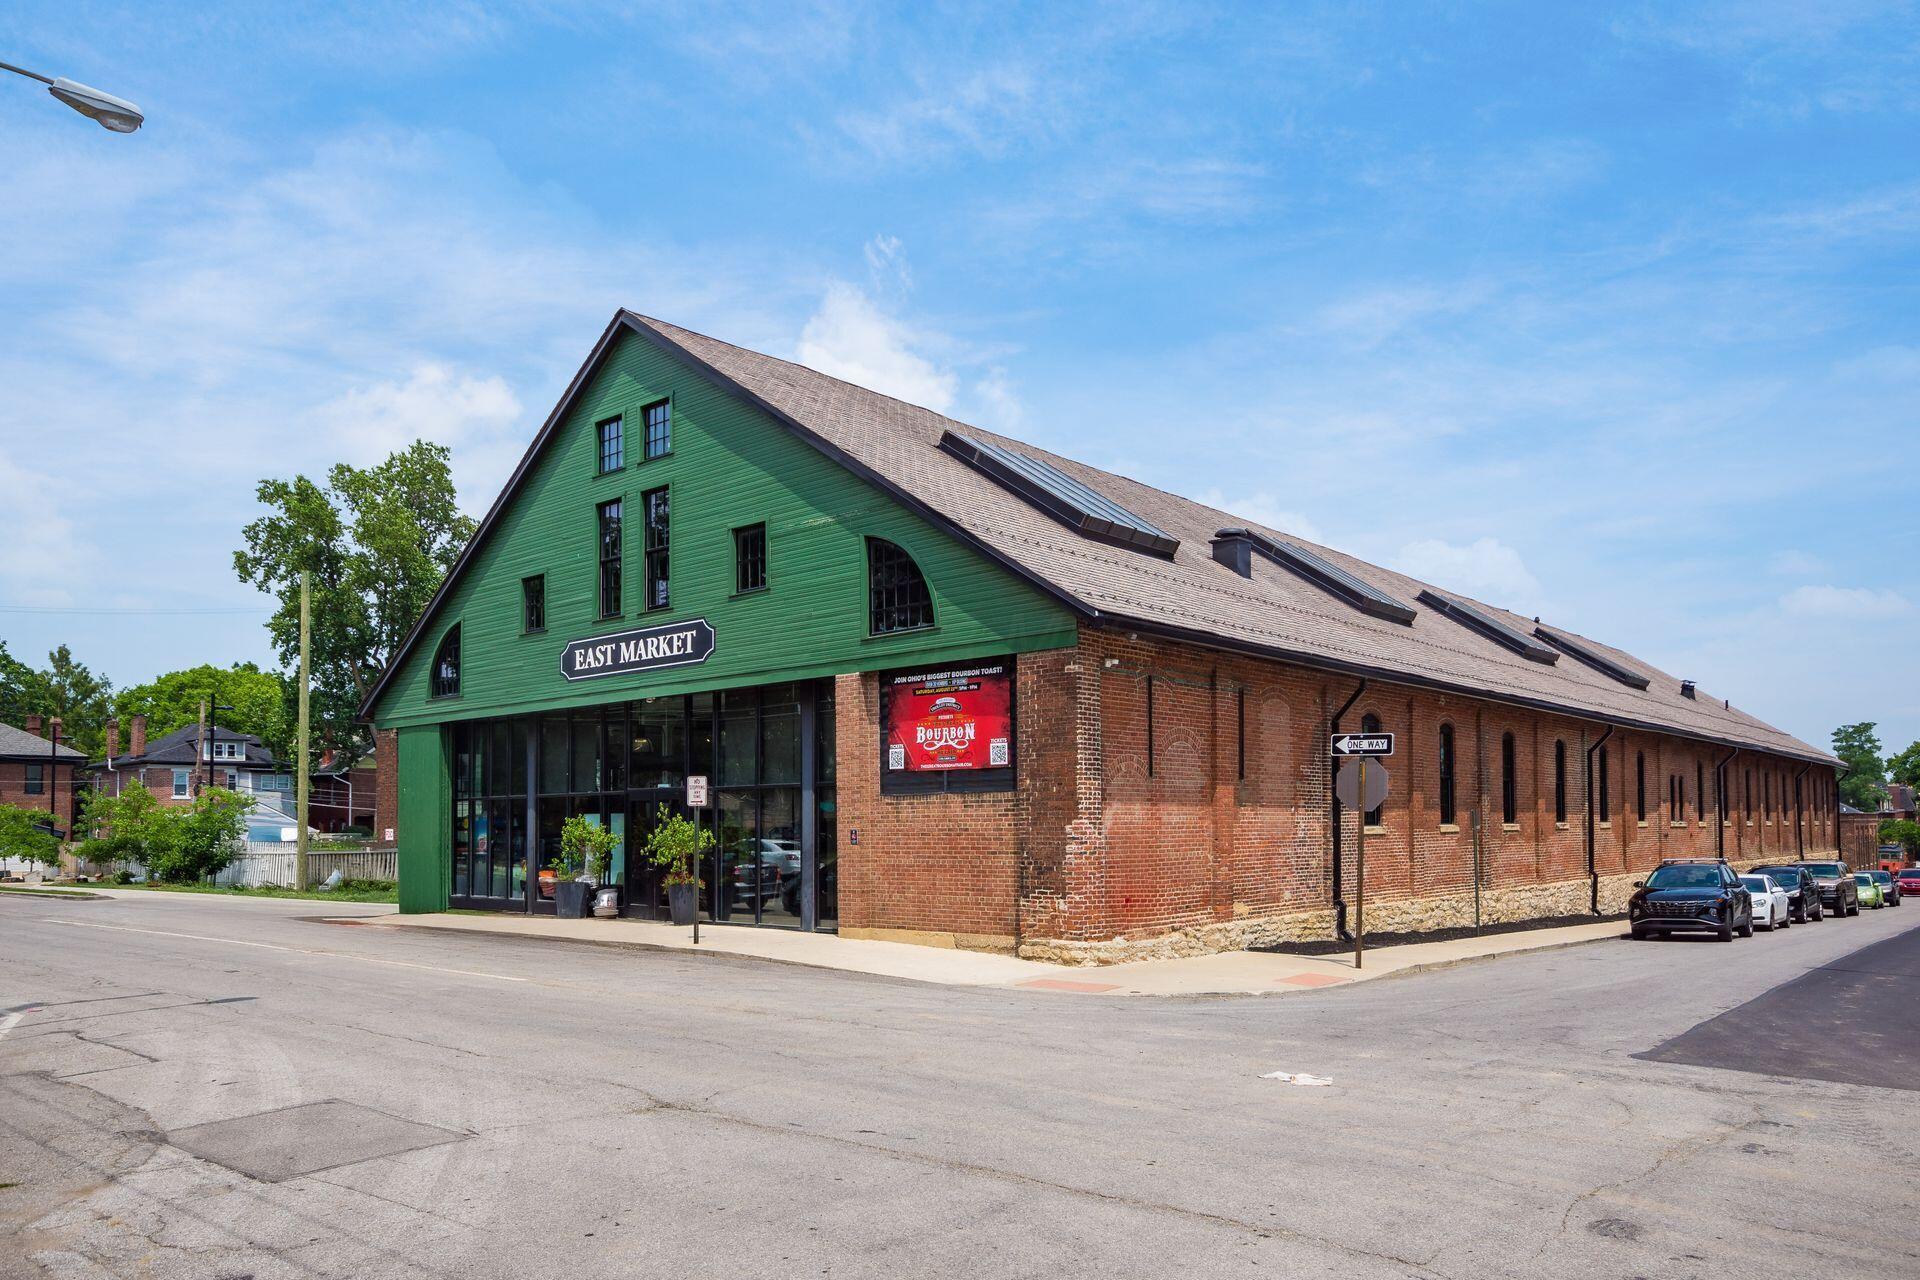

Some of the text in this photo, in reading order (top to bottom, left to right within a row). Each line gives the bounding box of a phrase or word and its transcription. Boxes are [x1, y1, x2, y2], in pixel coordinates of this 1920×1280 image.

[574, 629, 697, 671] EAST MARKET
[894, 666, 1003, 684] JOIN OHIO'S BIGGEST BOURBON TOAST!
[916, 722, 976, 750] BOURBON
[1347, 740, 1386, 749] ONE WAY
